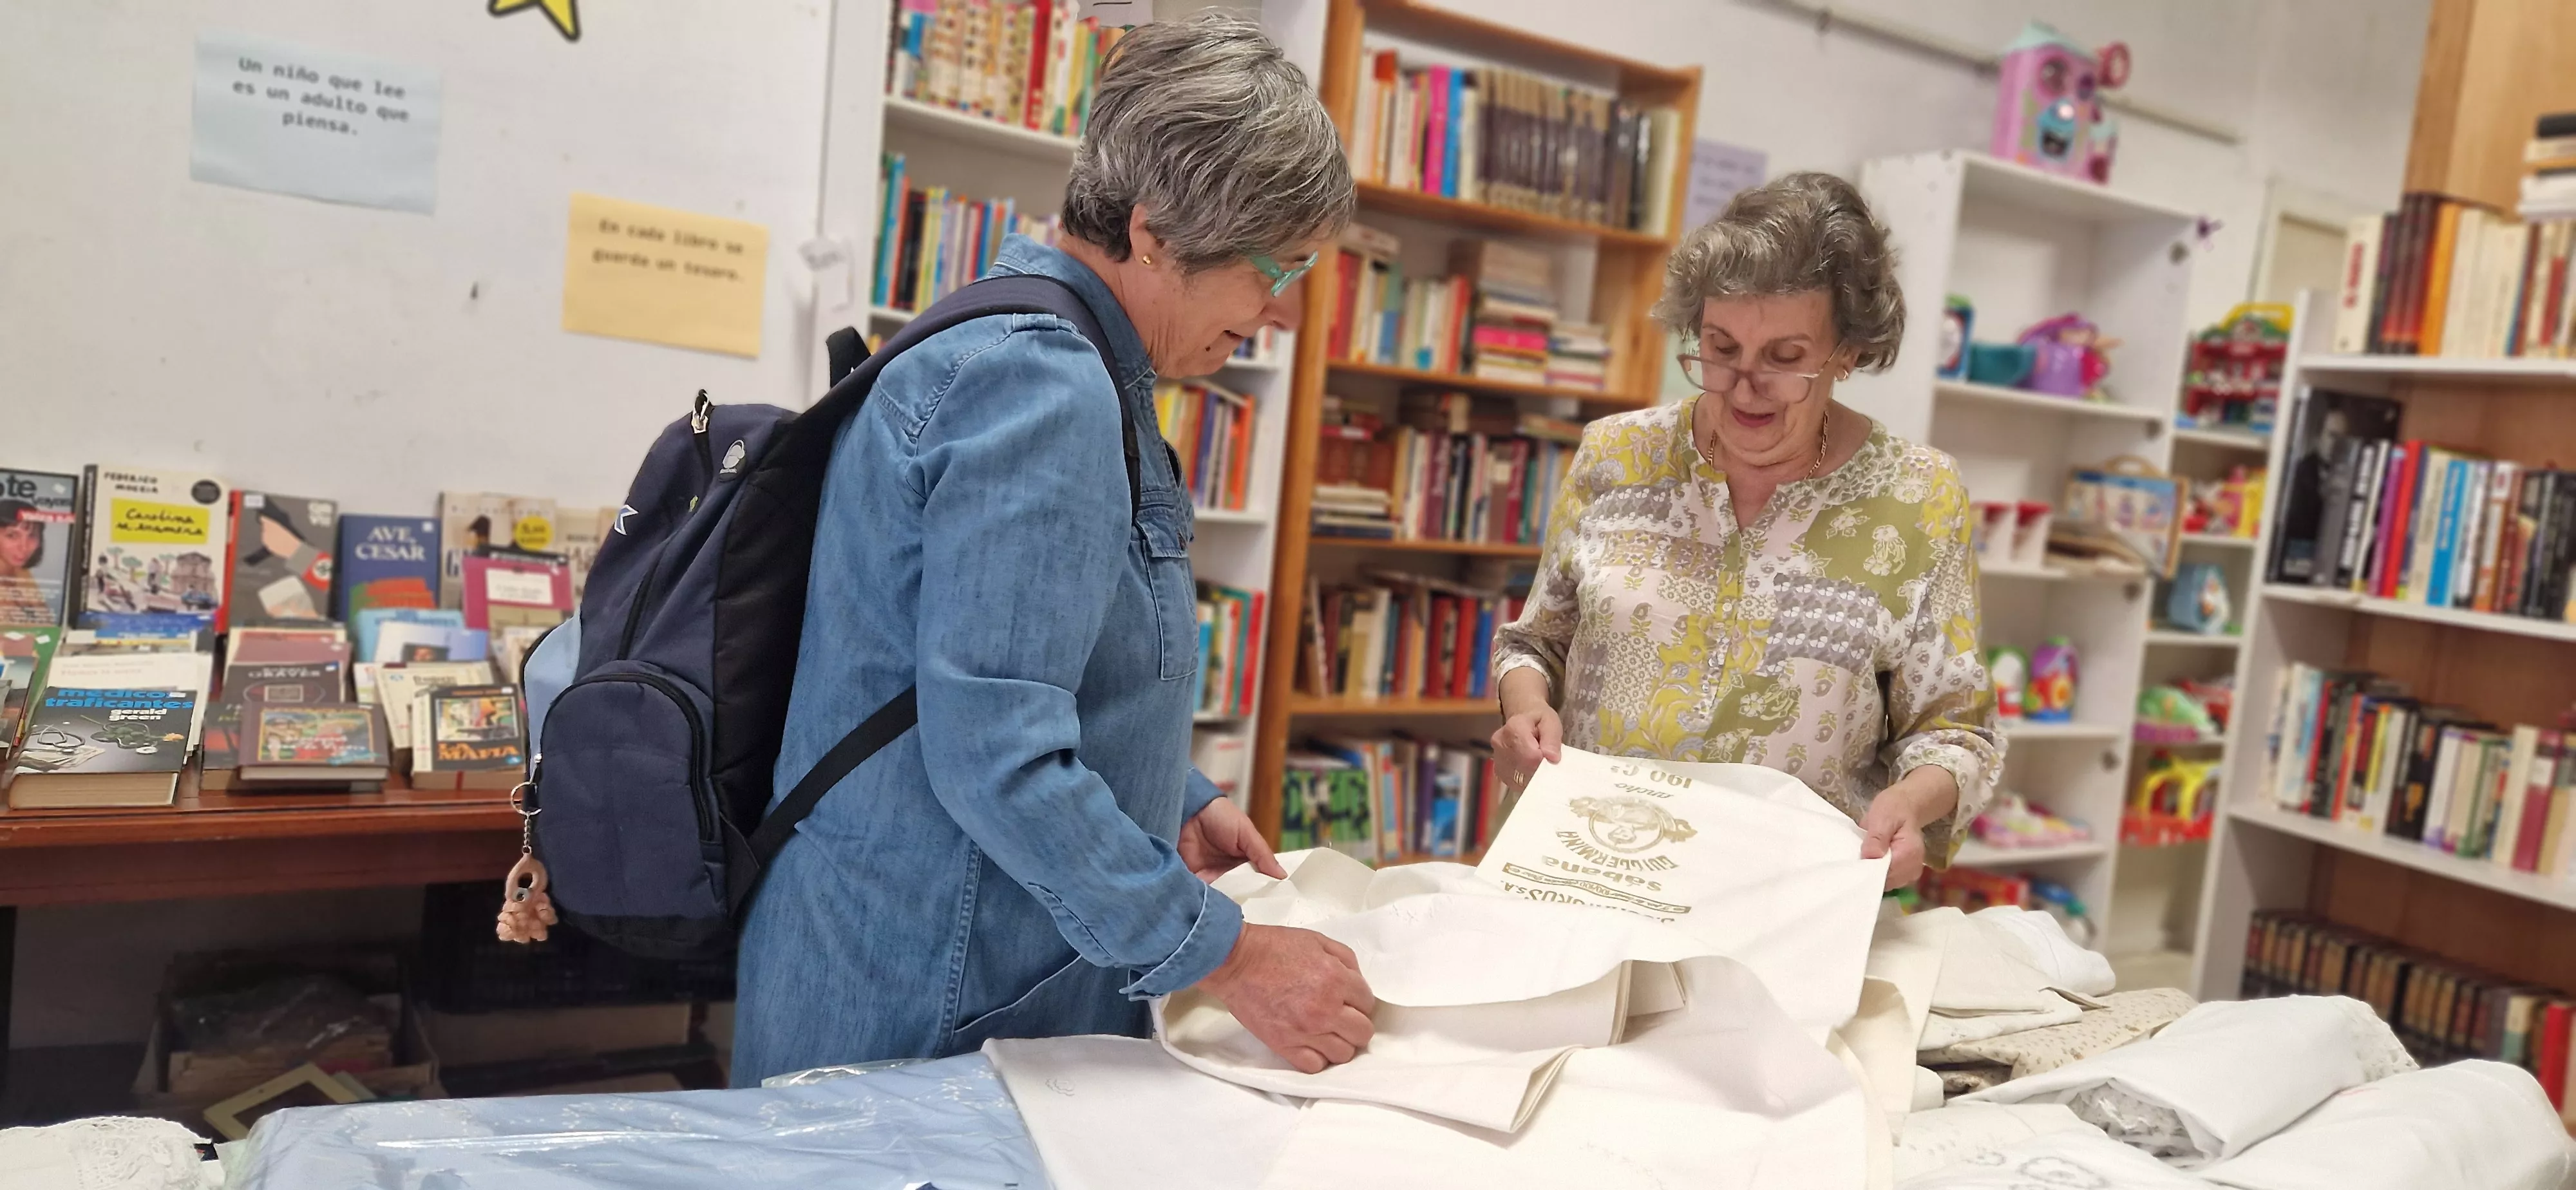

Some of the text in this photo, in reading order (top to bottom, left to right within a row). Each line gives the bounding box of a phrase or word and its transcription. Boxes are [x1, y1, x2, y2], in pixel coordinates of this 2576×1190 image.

[239, 57, 406, 99] Un niño que lee
[232, 81, 410, 122] es un adulto que
[282, 111, 357, 136] piensa.
[599, 218, 744, 254] En cada libro se
[592, 247, 650, 267] guarda
[656, 259, 677, 271] un
[126, 507, 194, 524] Carolina
[45, 697, 193, 708] traficantes
[1614, 783, 1674, 798] ancho
[1650, 770, 1692, 789] 190
[1556, 831, 1678, 872] GUILLERMINA
[1542, 855, 1662, 892] sábana
